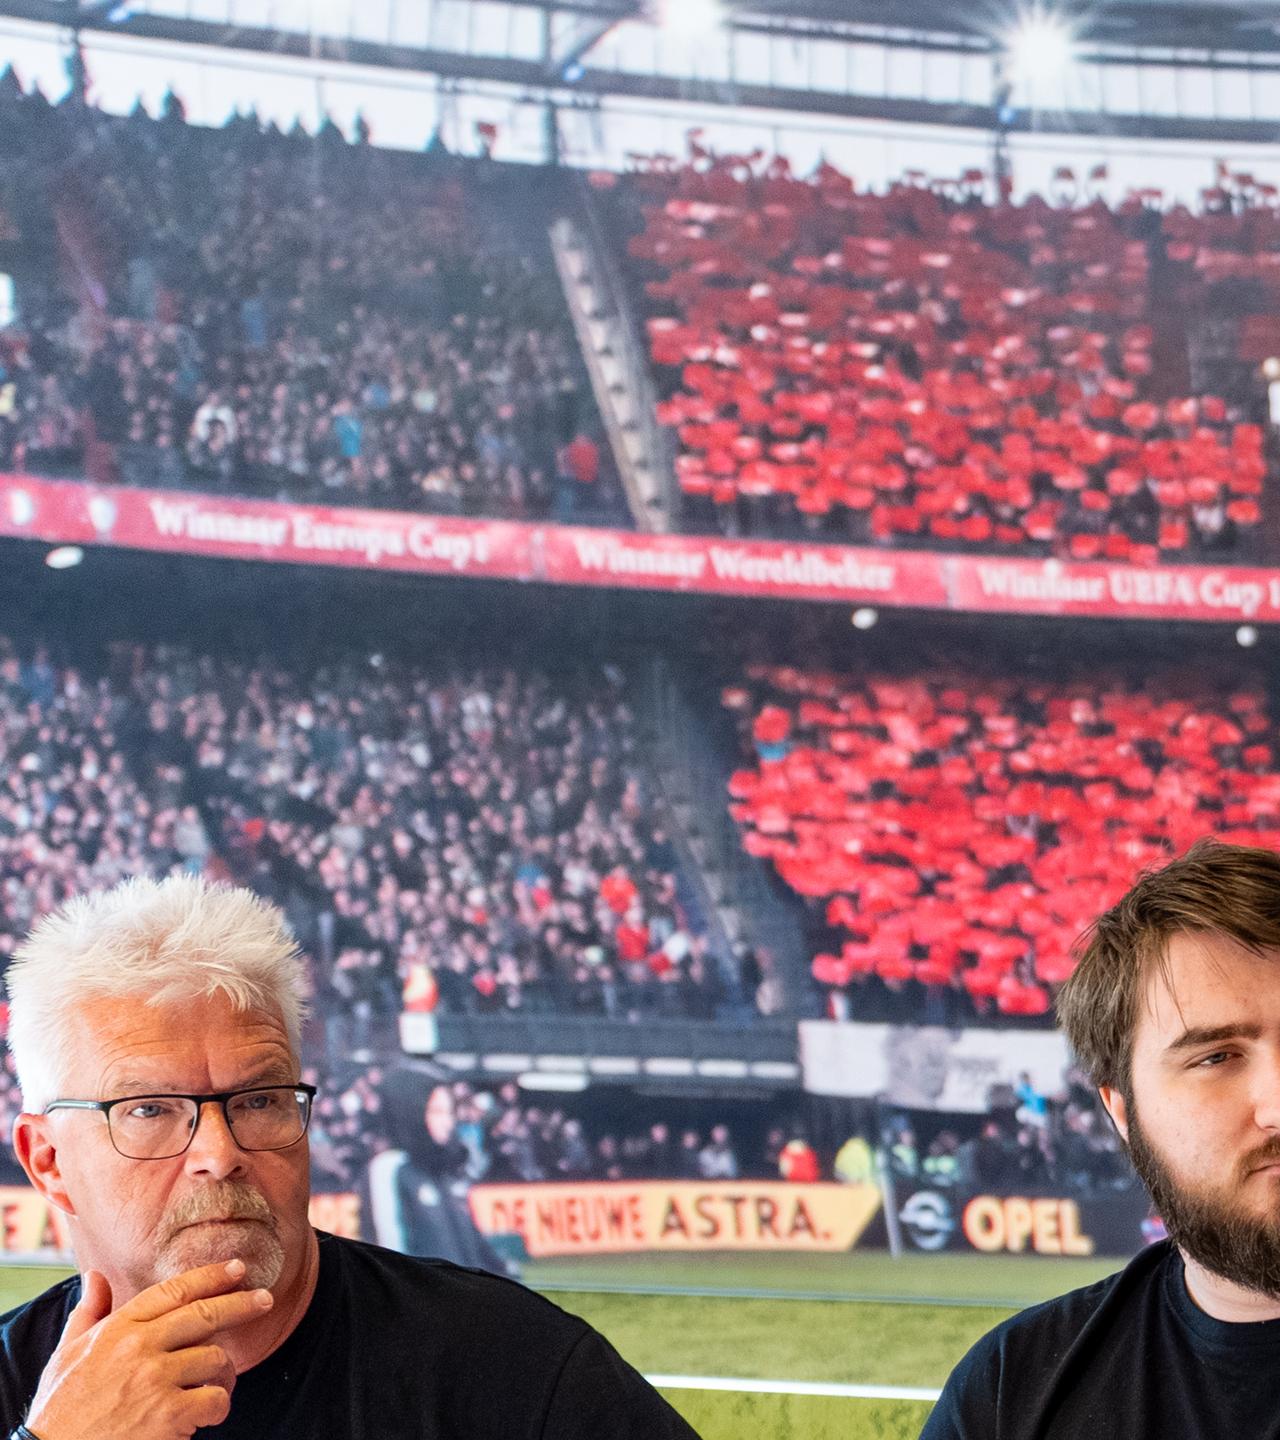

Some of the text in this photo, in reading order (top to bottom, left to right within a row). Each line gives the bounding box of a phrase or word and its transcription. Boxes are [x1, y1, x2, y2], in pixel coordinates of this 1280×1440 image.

[150, 499, 288, 546] Winnaar
[575, 534, 894, 591] Winnaar Wereldbeker
[978, 564, 1104, 600] Winnaar
[1108, 569, 1195, 605] UEFA
[1201, 573, 1263, 617] Cup
[538, 1194, 644, 1243] NIEUWE
[963, 1195, 1095, 1257] OPEL
